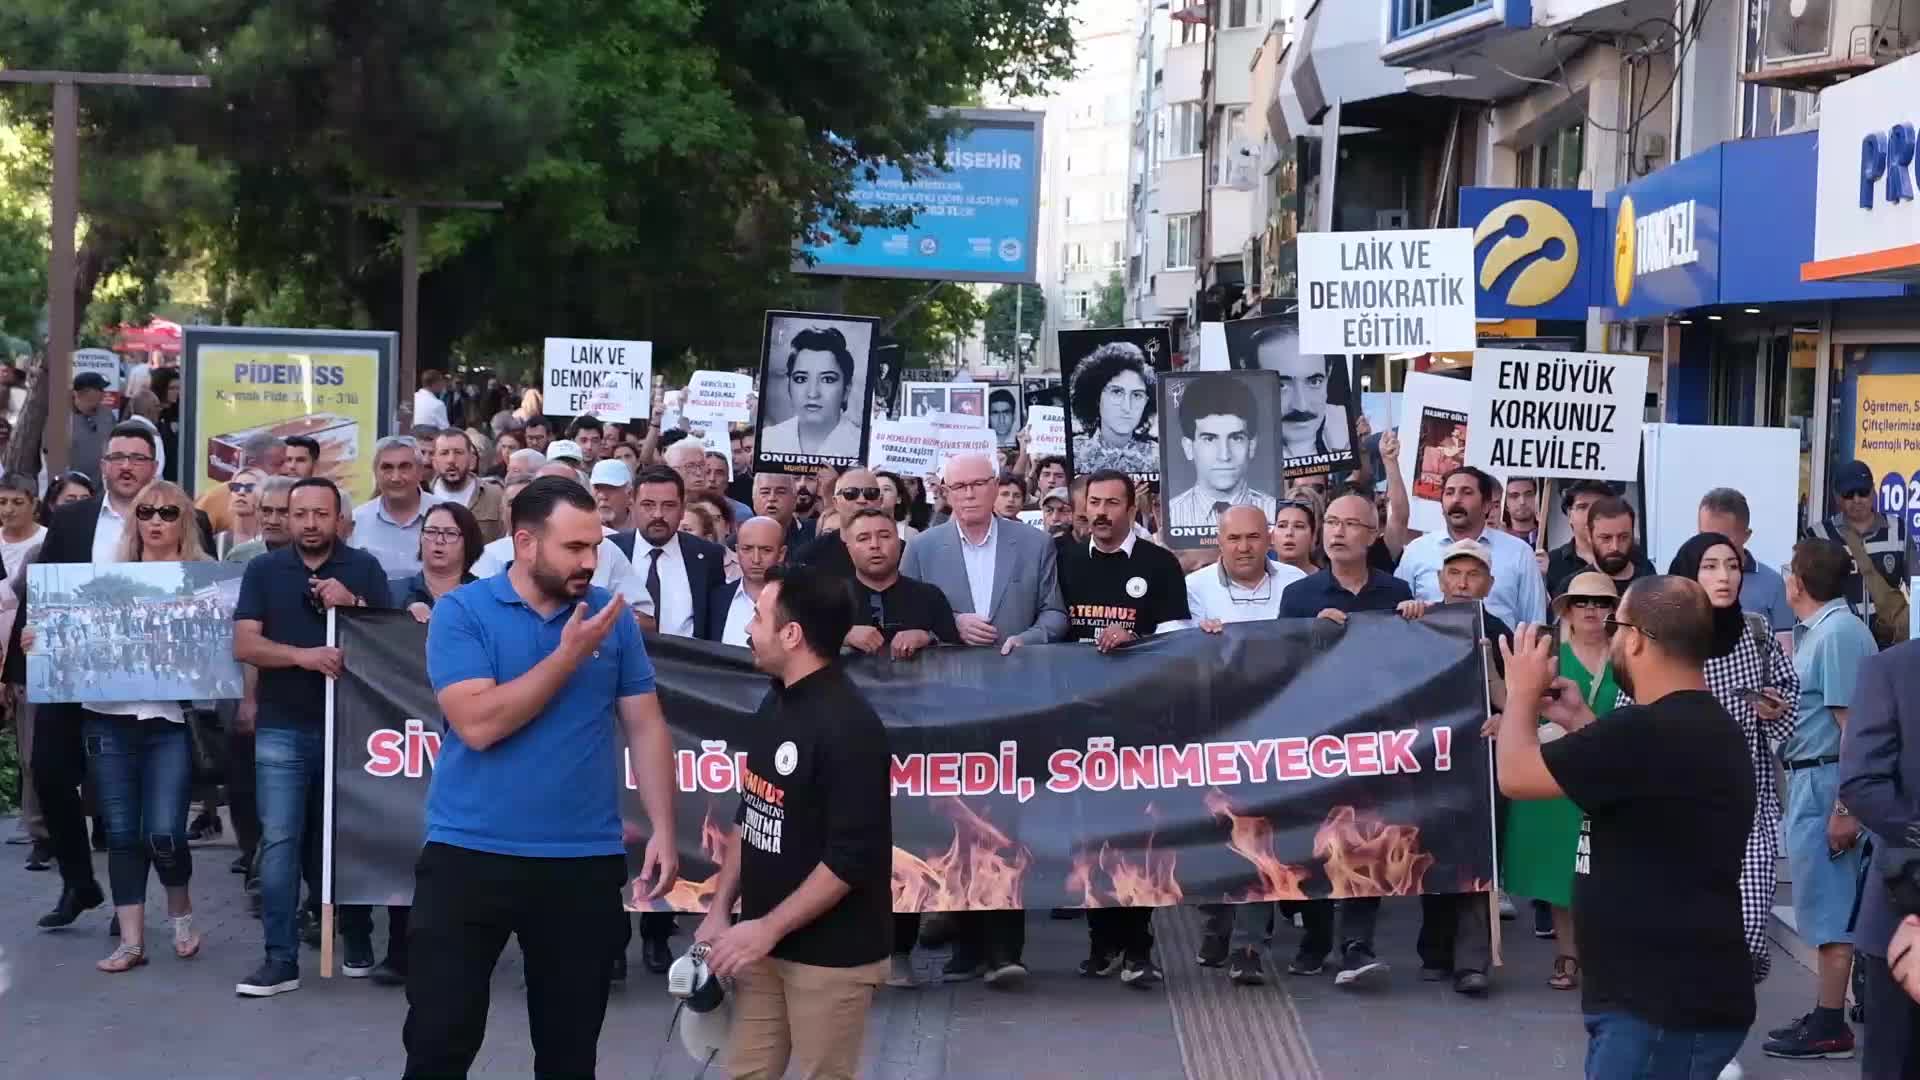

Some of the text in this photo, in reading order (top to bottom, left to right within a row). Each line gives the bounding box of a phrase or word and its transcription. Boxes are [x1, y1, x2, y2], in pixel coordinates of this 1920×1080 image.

[1859, 121, 1920, 211] PR
[1340, 237, 1432, 271] LAİK VE
[1635, 199, 1699, 276] TURKCELL
[1310, 273, 1464, 310] DEMOKRATİK
[1343, 313, 1431, 348] EĞİTİM.
[570, 343, 626, 366] LAİK VE
[551, 368, 645, 391] DEMOKİK
[1498, 358, 1616, 395] EN BÜYÜK
[1489, 399, 1617, 433] KORKUNUZ
[1862, 397, 1912, 416] Öğretmen,
[759, 453, 860, 468] ONURUMUZ
[1489, 435, 1606, 471] ALEVİLER.
[1861, 438, 1902, 453] Avantajlı
[1882, 484, 1904, 511] 10
[1075, 604, 1137, 620] TEMMUZ
[1047, 728, 1420, 794] SÖNMEYECEK
[1433, 726, 1452, 771] !
